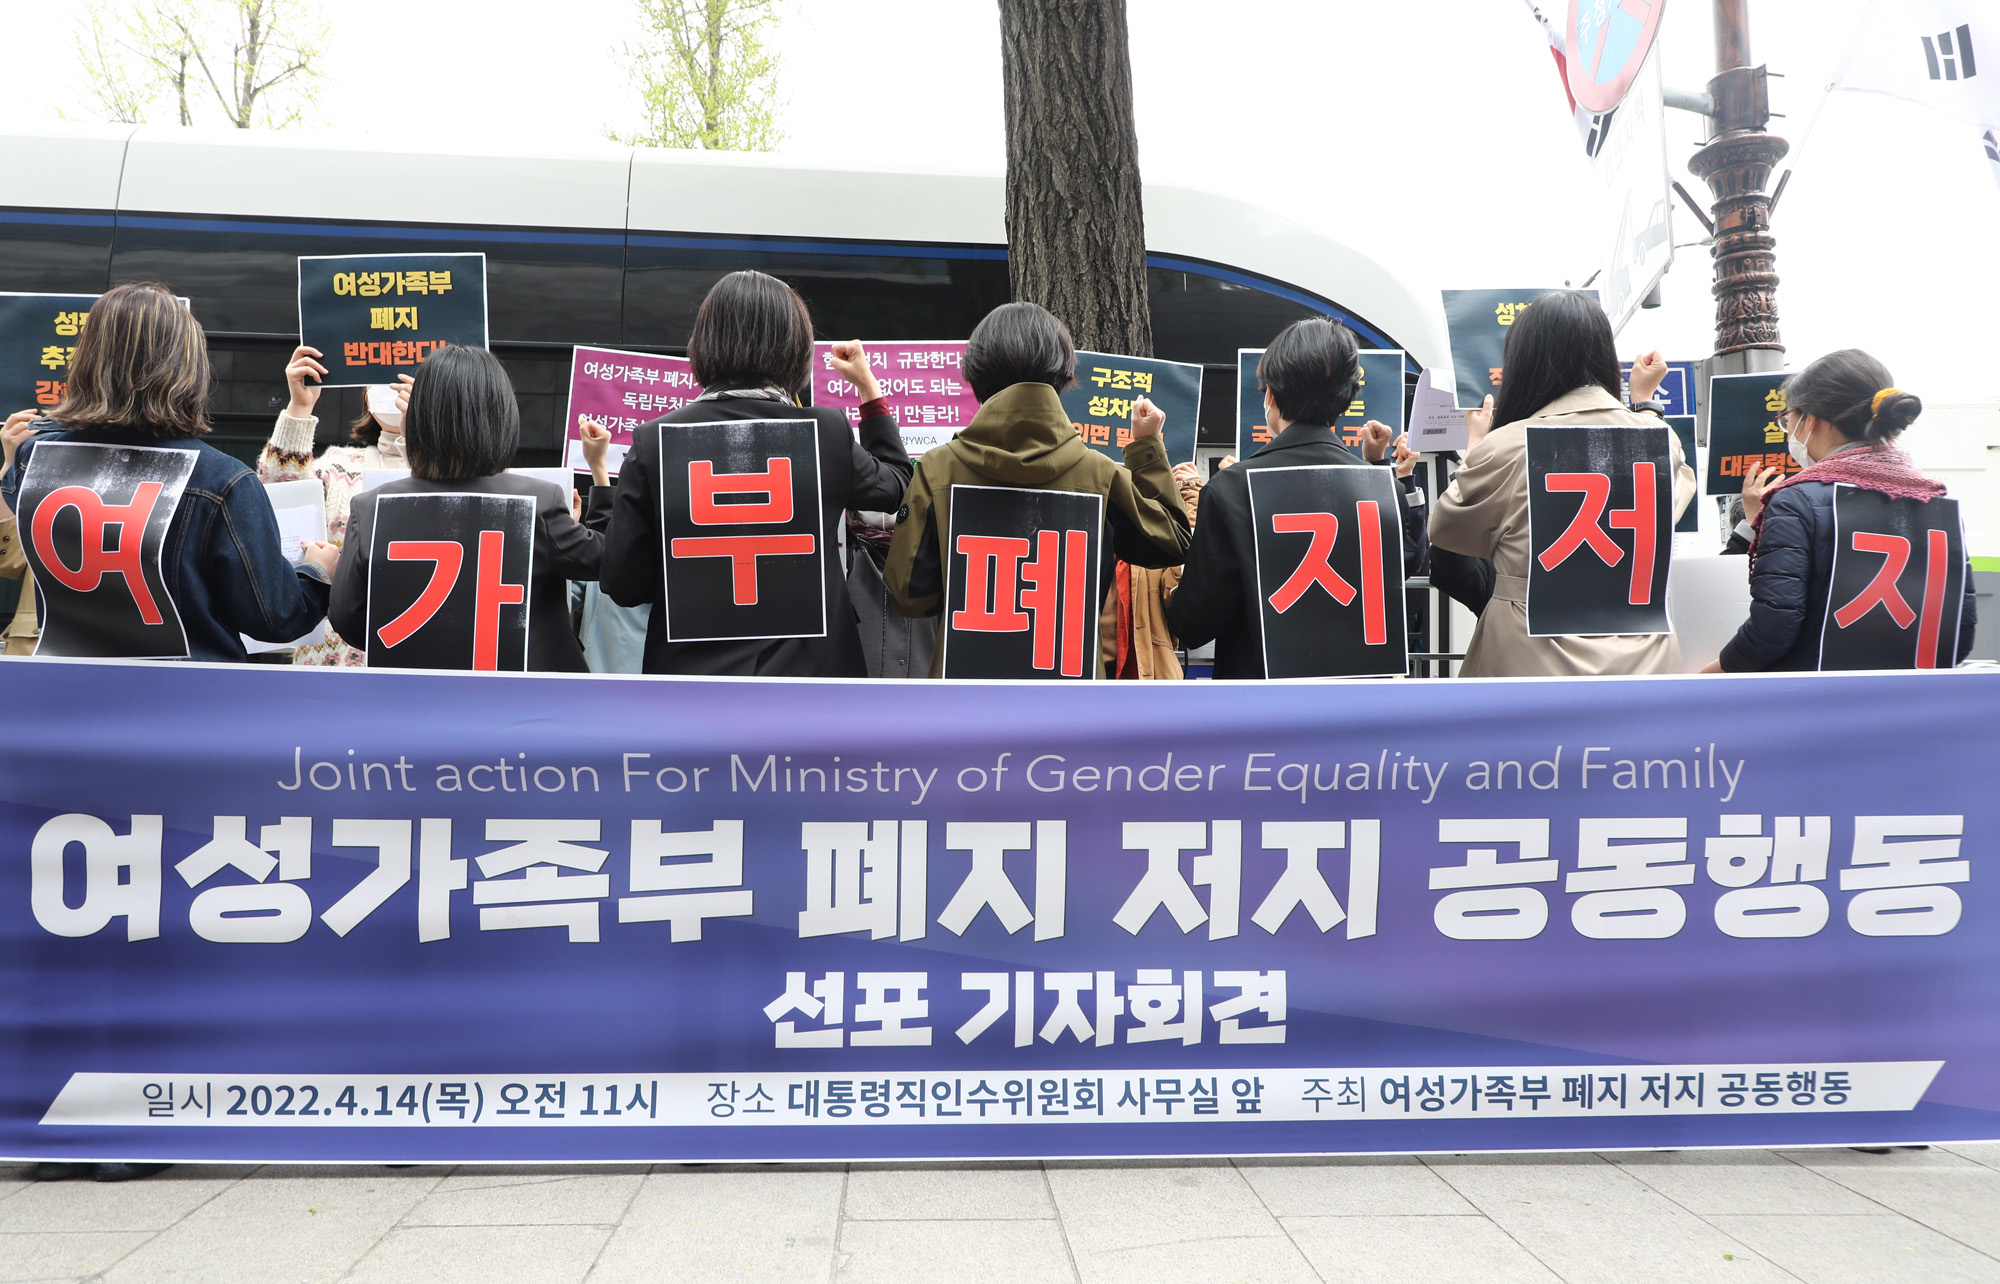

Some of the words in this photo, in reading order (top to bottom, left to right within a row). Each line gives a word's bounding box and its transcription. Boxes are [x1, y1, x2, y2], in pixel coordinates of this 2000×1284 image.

[333, 270, 452, 297] 여성가족부
[370, 306, 419, 331] 폐지
[583, 361, 660, 386] 여성가족부
[662, 370, 699, 390] 폐지
[929, 378, 963, 396] 되는
[1088, 395, 1134, 419] 성차
[1090, 366, 1153, 393] 구조적
[577, 413, 645, 434] 여성가족
[904, 405, 960, 424] 만들라!
[33, 483, 163, 624] 여
[671, 456, 815, 606] 부
[1538, 462, 1656, 606] 저
[377, 530, 524, 671] 가
[952, 529, 1088, 677] 폐
[1269, 500, 1387, 645] 지
[1833, 529, 1948, 669] 지
[277, 746, 416, 792] Joint
[435, 752, 600, 793] action
[622, 752, 709, 793] For
[730, 753, 939, 806] Ministry
[956, 752, 1012, 793] of
[1026, 751, 1227, 793] Gender
[1243, 748, 1449, 805] Equality
[1465, 744, 1563, 791] and
[1581, 742, 1746, 803] Family
[31, 812, 753, 943] 여성가족부
[798, 819, 1067, 942] 폐지
[1112, 819, 1381, 942] 저지
[1428, 814, 1970, 941] 공동행동
[763, 971, 933, 1049] 선포
[955, 968, 1288, 1048] 기자회견
[142, 1081, 212, 1118] 일시
[226, 1081, 484, 1124] 2022.4.14(목)
[496, 1080, 566, 1119] 오전
[580, 1080, 658, 1119] 11시
[707, 1080, 775, 1118] 장소
[787, 1078, 1105, 1117] 대통령직인수위원회
[1116, 1078, 1221, 1115] 사무실
[1231, 1076, 1265, 1115] 앞
[1301, 1076, 1366, 1113] 주최
[1380, 1074, 1552, 1113] 여성가족부
[1561, 1073, 1627, 1110] 폐지
[1639, 1072, 1706, 1109] 저지
[1717, 1070, 1853, 1107] 공동행동
